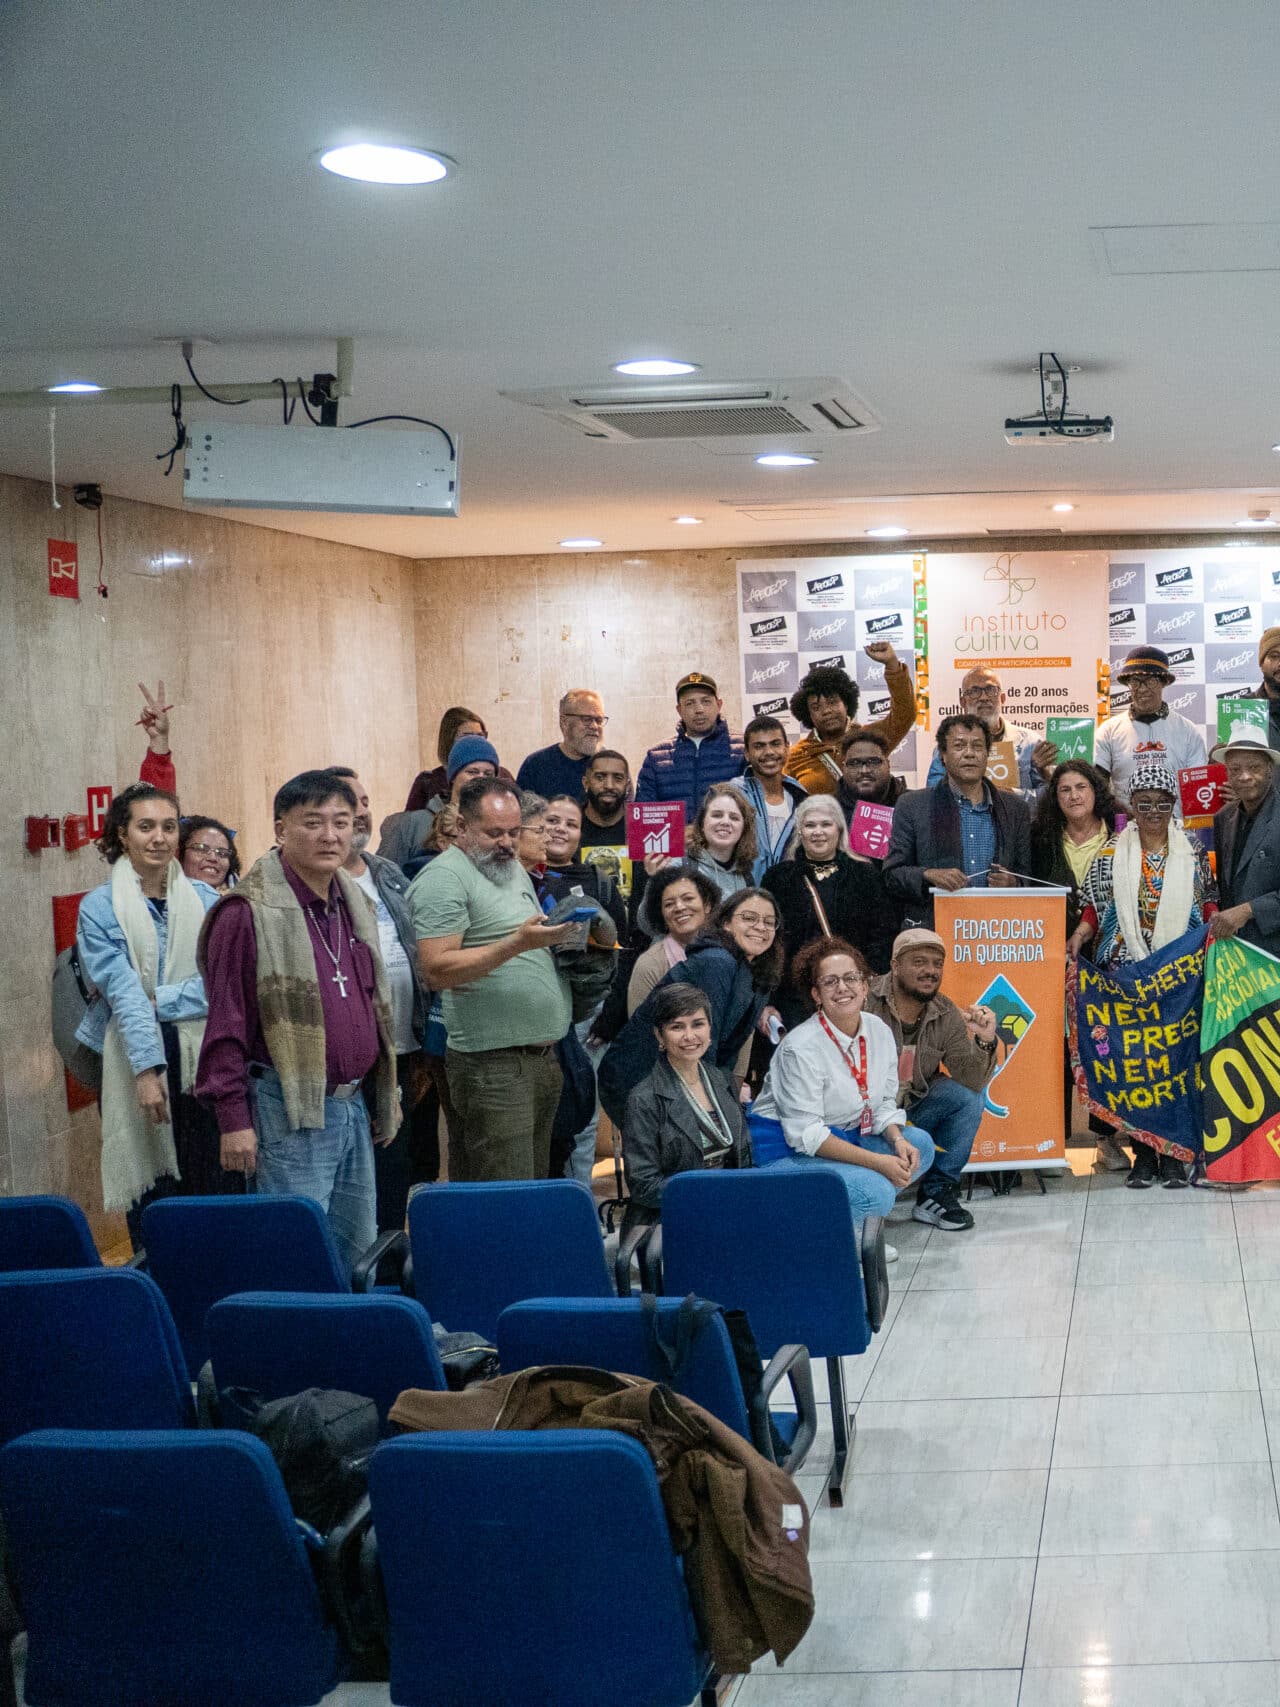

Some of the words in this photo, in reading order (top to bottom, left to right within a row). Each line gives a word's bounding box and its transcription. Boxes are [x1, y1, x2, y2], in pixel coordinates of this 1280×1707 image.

[963, 610, 1067, 632] instituto
[954, 631, 1039, 652] cultiva
[1045, 659, 1067, 667] SOCIAL
[1007, 687, 1022, 698] de
[1024, 687, 1038, 698] 20
[1041, 687, 1069, 698] anos
[1001, 703, 1090, 717] transformações
[1222, 703, 1231, 714] 15
[1050, 719, 1058, 732] 3
[1182, 771, 1189, 783] 5
[633, 807, 641, 820] 8
[860, 805, 871, 818] 10
[954, 918, 1044, 940] PEDAGOGIAS
[954, 944, 972, 963] DA
[976, 944, 1044, 965] QUEBRADA
[1086, 1001, 1161, 1026] NEM
[1092, 1054, 1171, 1084] NEM
[1105, 1063, 1202, 1112] MORT
